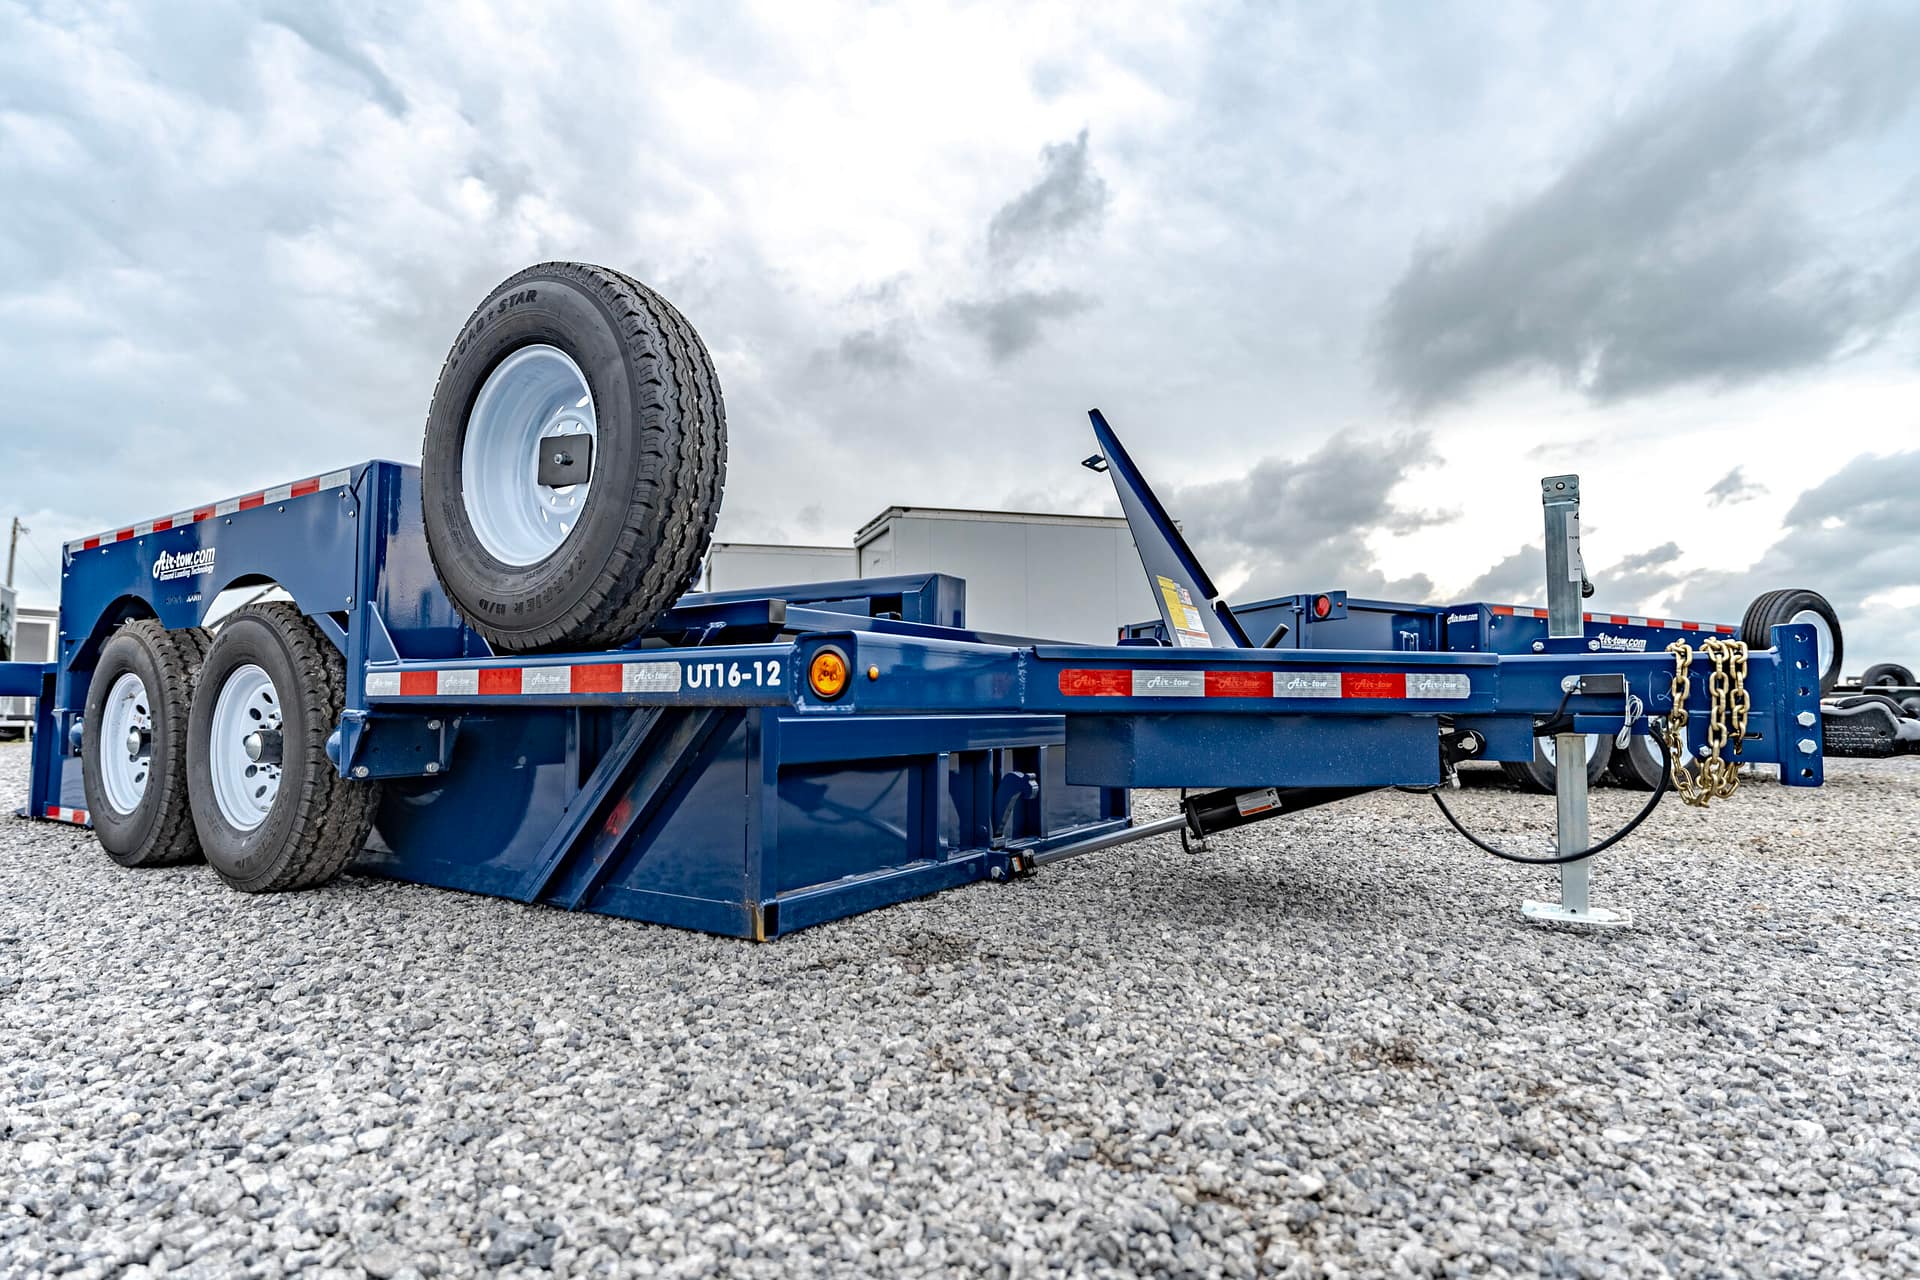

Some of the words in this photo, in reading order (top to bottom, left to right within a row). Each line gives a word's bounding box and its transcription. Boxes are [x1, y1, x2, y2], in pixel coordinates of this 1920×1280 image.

[497, 289, 538, 314] STAR
[686, 660, 781, 689] UT16-12
[1146, 674, 1191, 689] Air-tow
[1286, 677, 1328, 690] Air-tow
[1418, 679, 1458, 691] Air-tow
